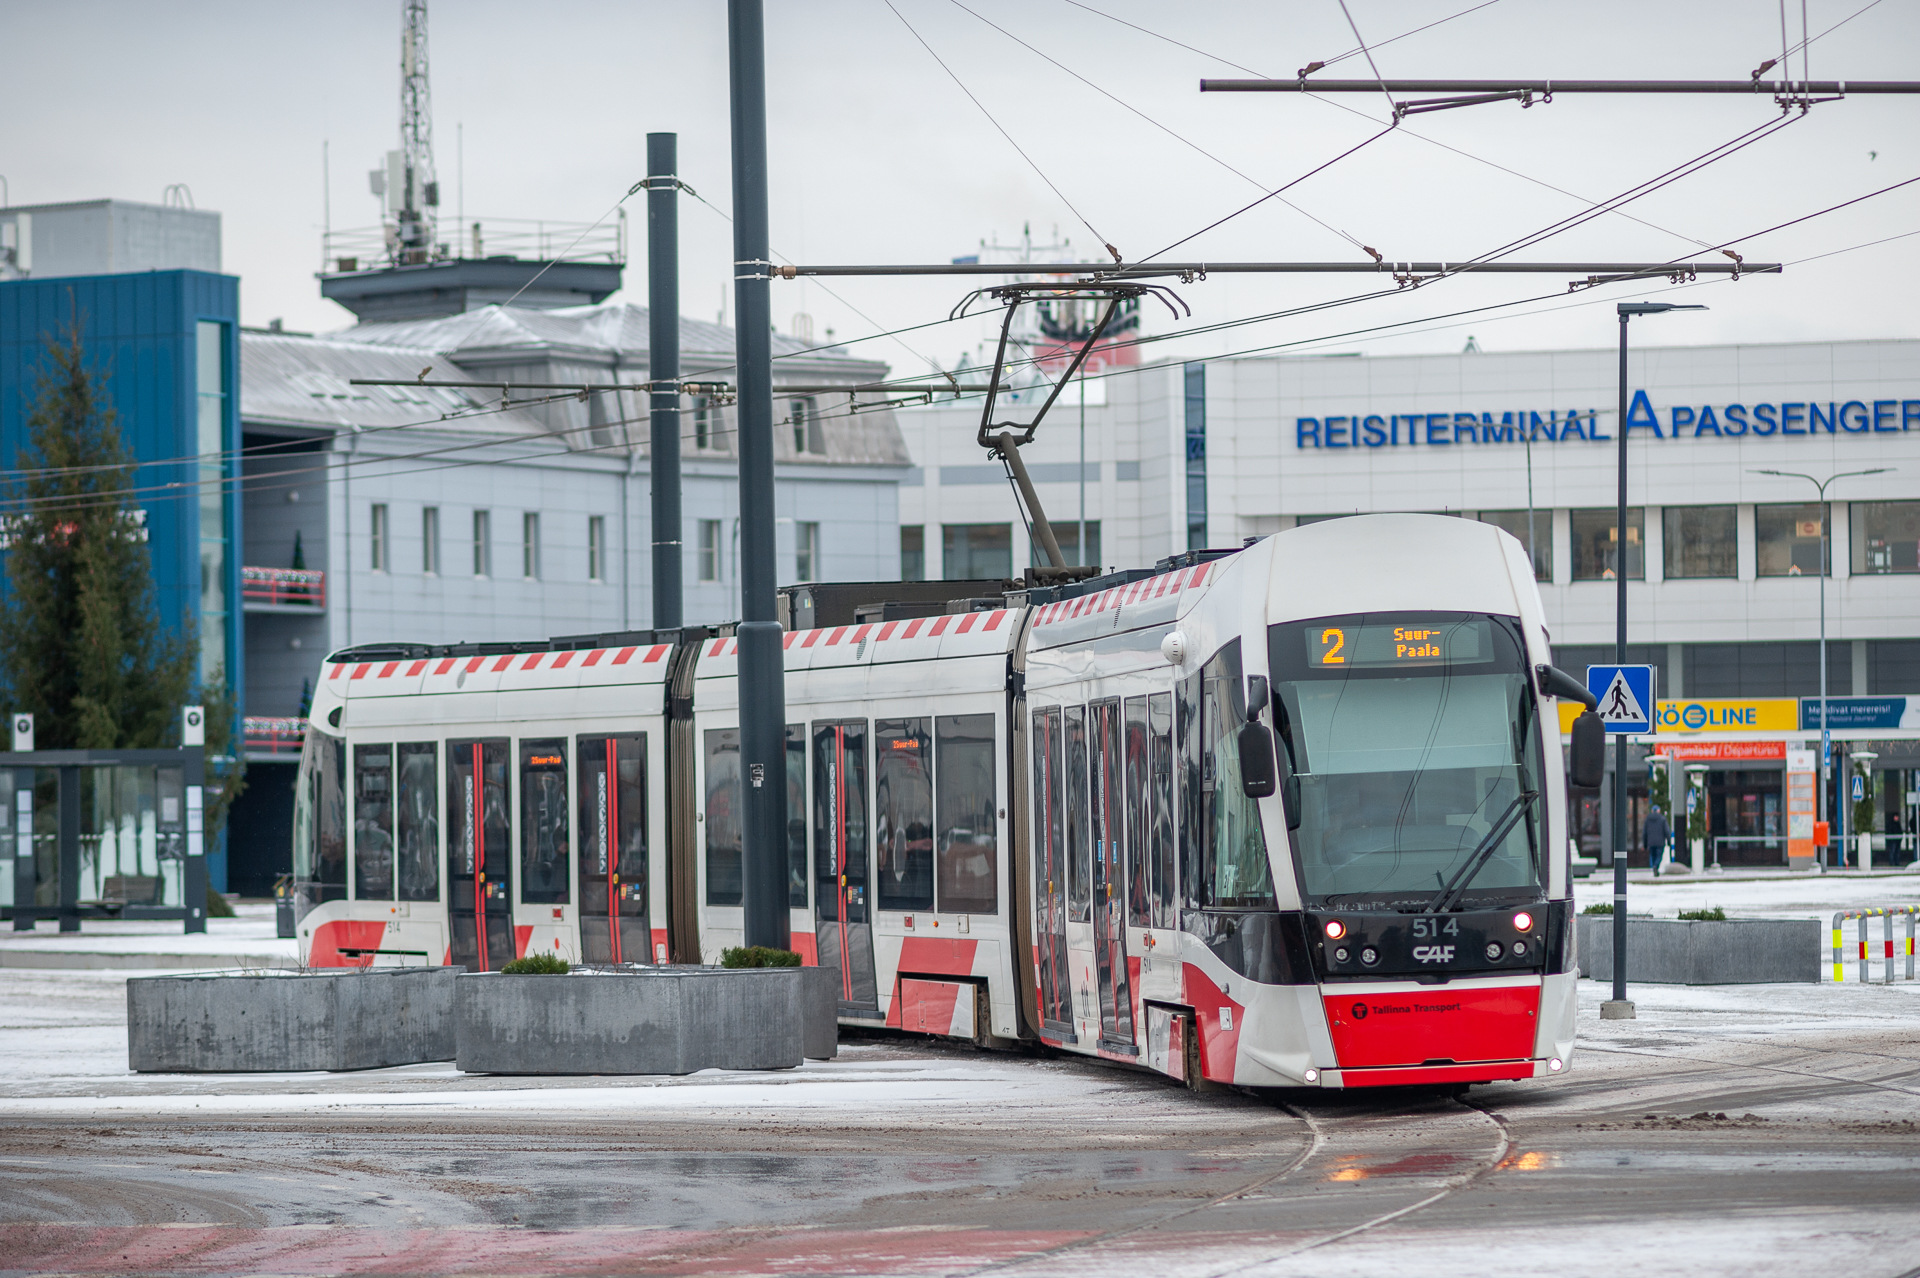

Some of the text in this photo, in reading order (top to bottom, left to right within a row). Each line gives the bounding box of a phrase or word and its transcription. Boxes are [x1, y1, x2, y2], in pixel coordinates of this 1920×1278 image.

[1296, 388, 1920, 449] REISITERMINAL A PASSENGER
[1393, 627, 1441, 642] Suur-
[1321, 628, 1345, 664] 2
[1396, 643, 1440, 658] Paala
[1709, 707, 1757, 725] LINE
[1808, 705, 1849, 715] Meldivat
[1723, 744, 1780, 757] Departures
[388, 921, 401, 934] 514
[1412, 917, 1459, 938] 514
[1412, 945, 1456, 963] CAF
[1371, 1003, 1462, 1015] Tallinna Transport
